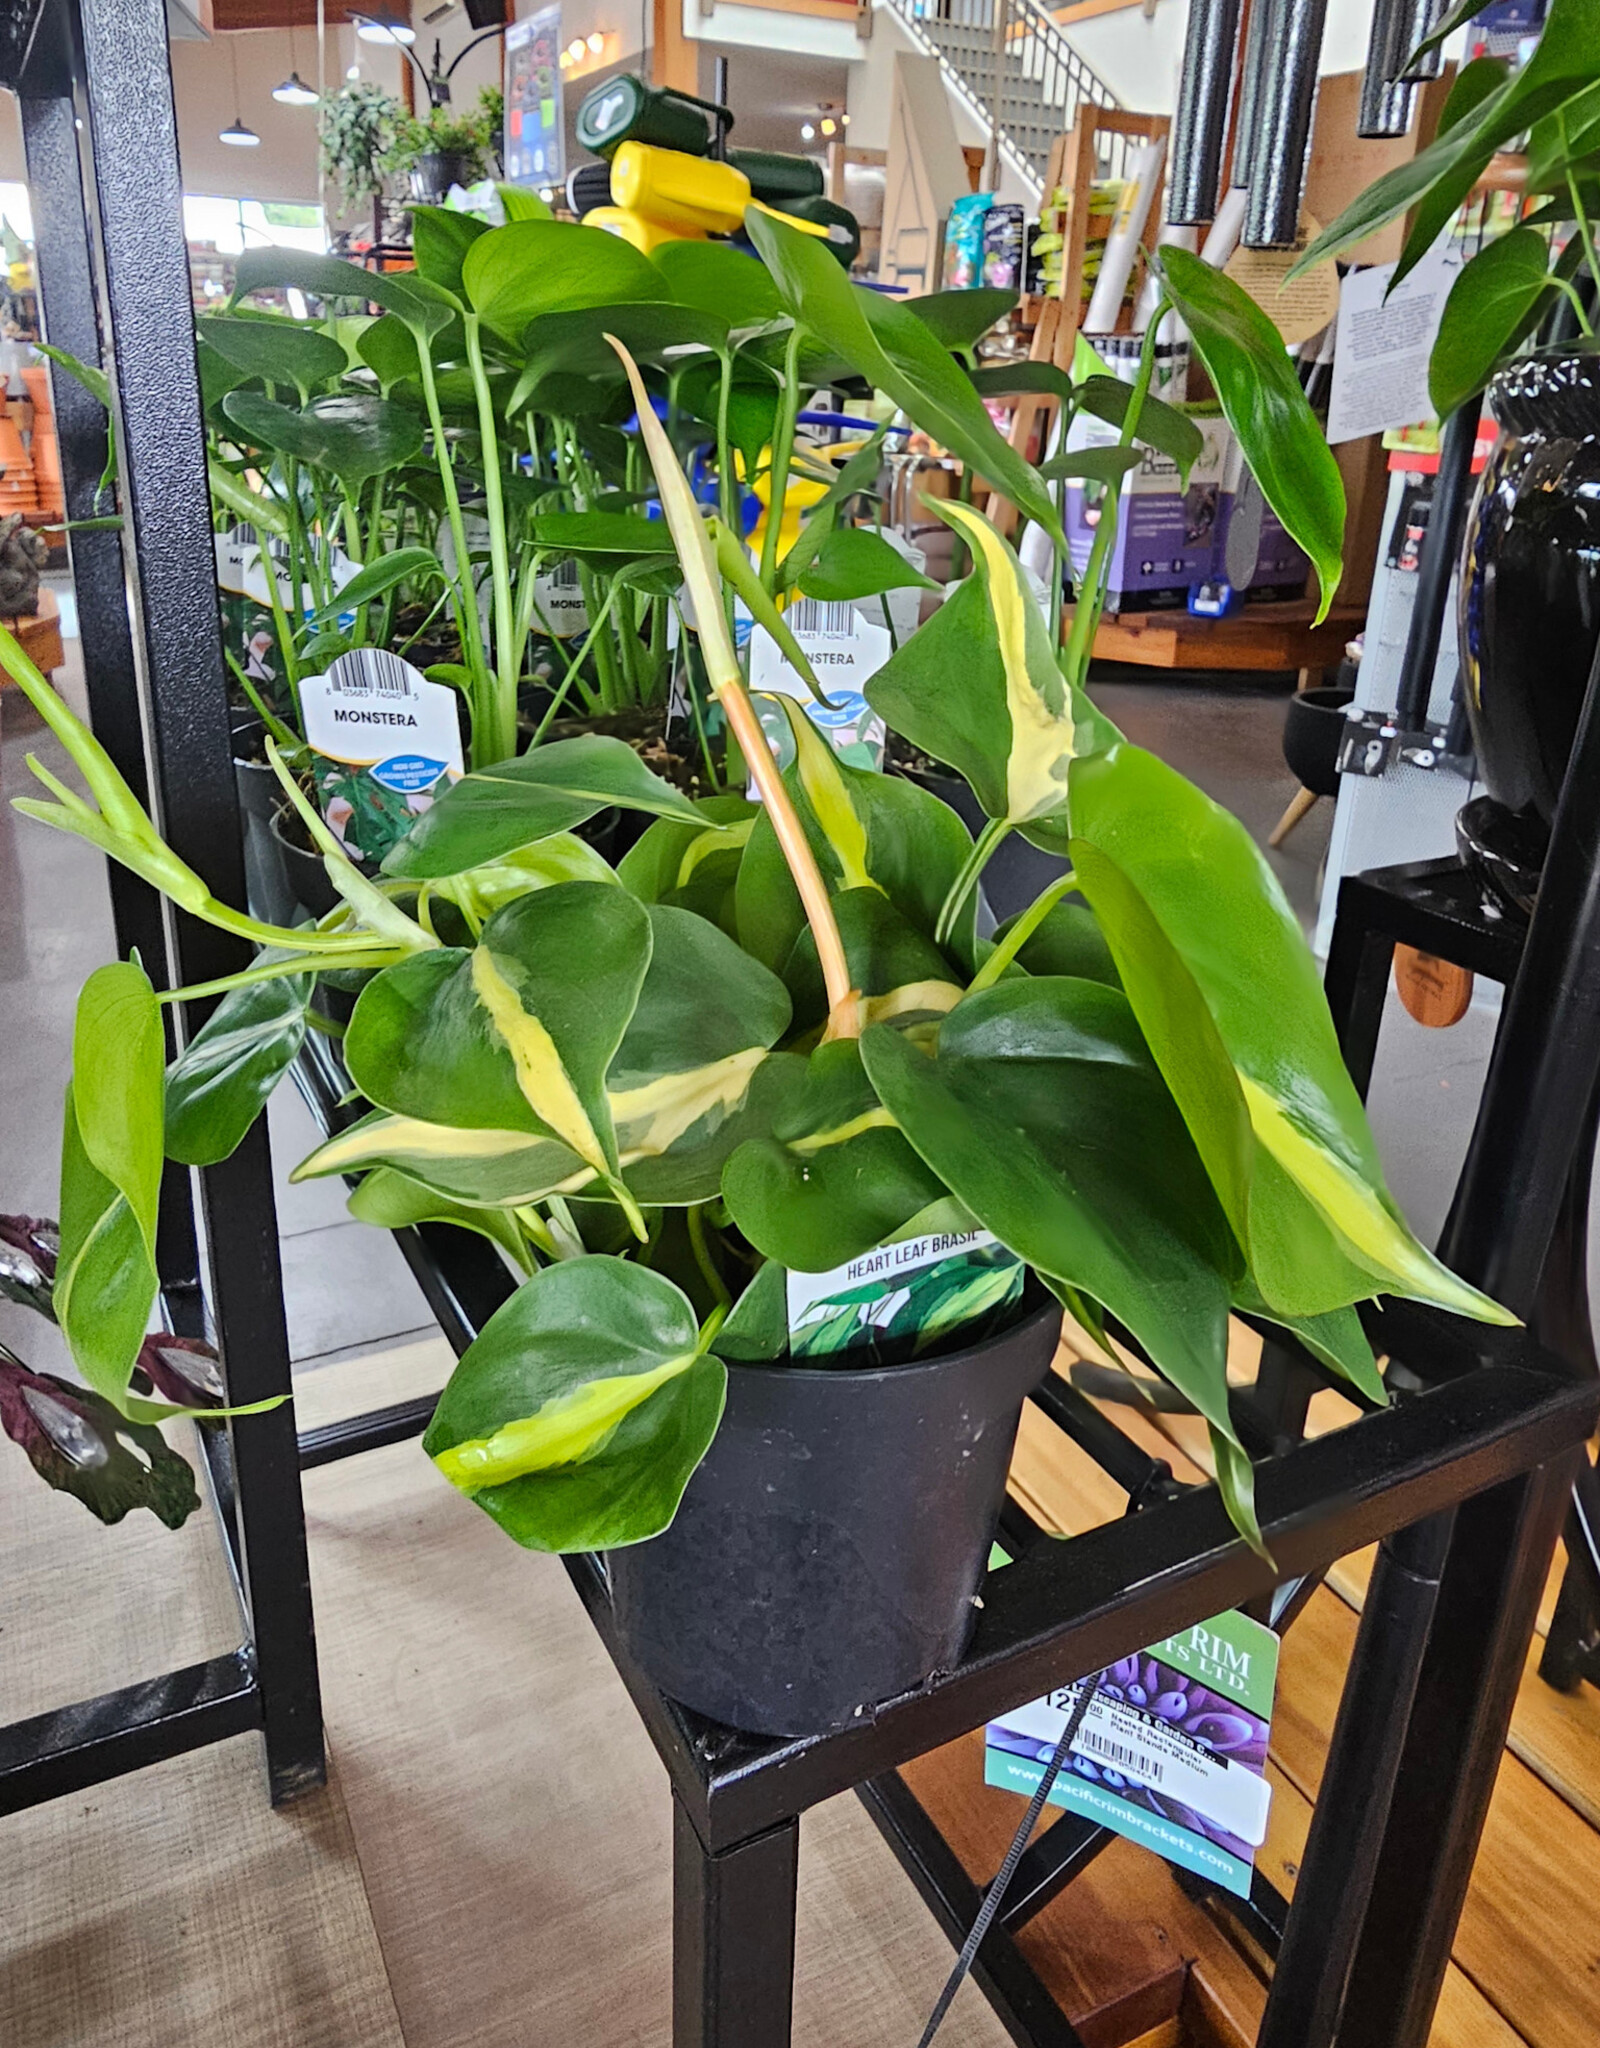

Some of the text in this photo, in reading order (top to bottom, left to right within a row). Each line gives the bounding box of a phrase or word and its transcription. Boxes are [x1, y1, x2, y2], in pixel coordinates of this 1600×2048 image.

[334, 709, 418, 727] MONSTERA
[847, 1231, 979, 1281] HEART LEAF BRASIL
[1189, 1624, 1252, 1680] RIM
[1199, 1656, 1251, 1697] LTD.
[1110, 1712, 1144, 1733] Nested
[1146, 1728, 1203, 1765] Rectangular
[1110, 1720, 1134, 1738] Plant
[1171, 1751, 1210, 1777] Medium
[1142, 1713, 1152, 1725] &
[1154, 1719, 1195, 1750] Garden
